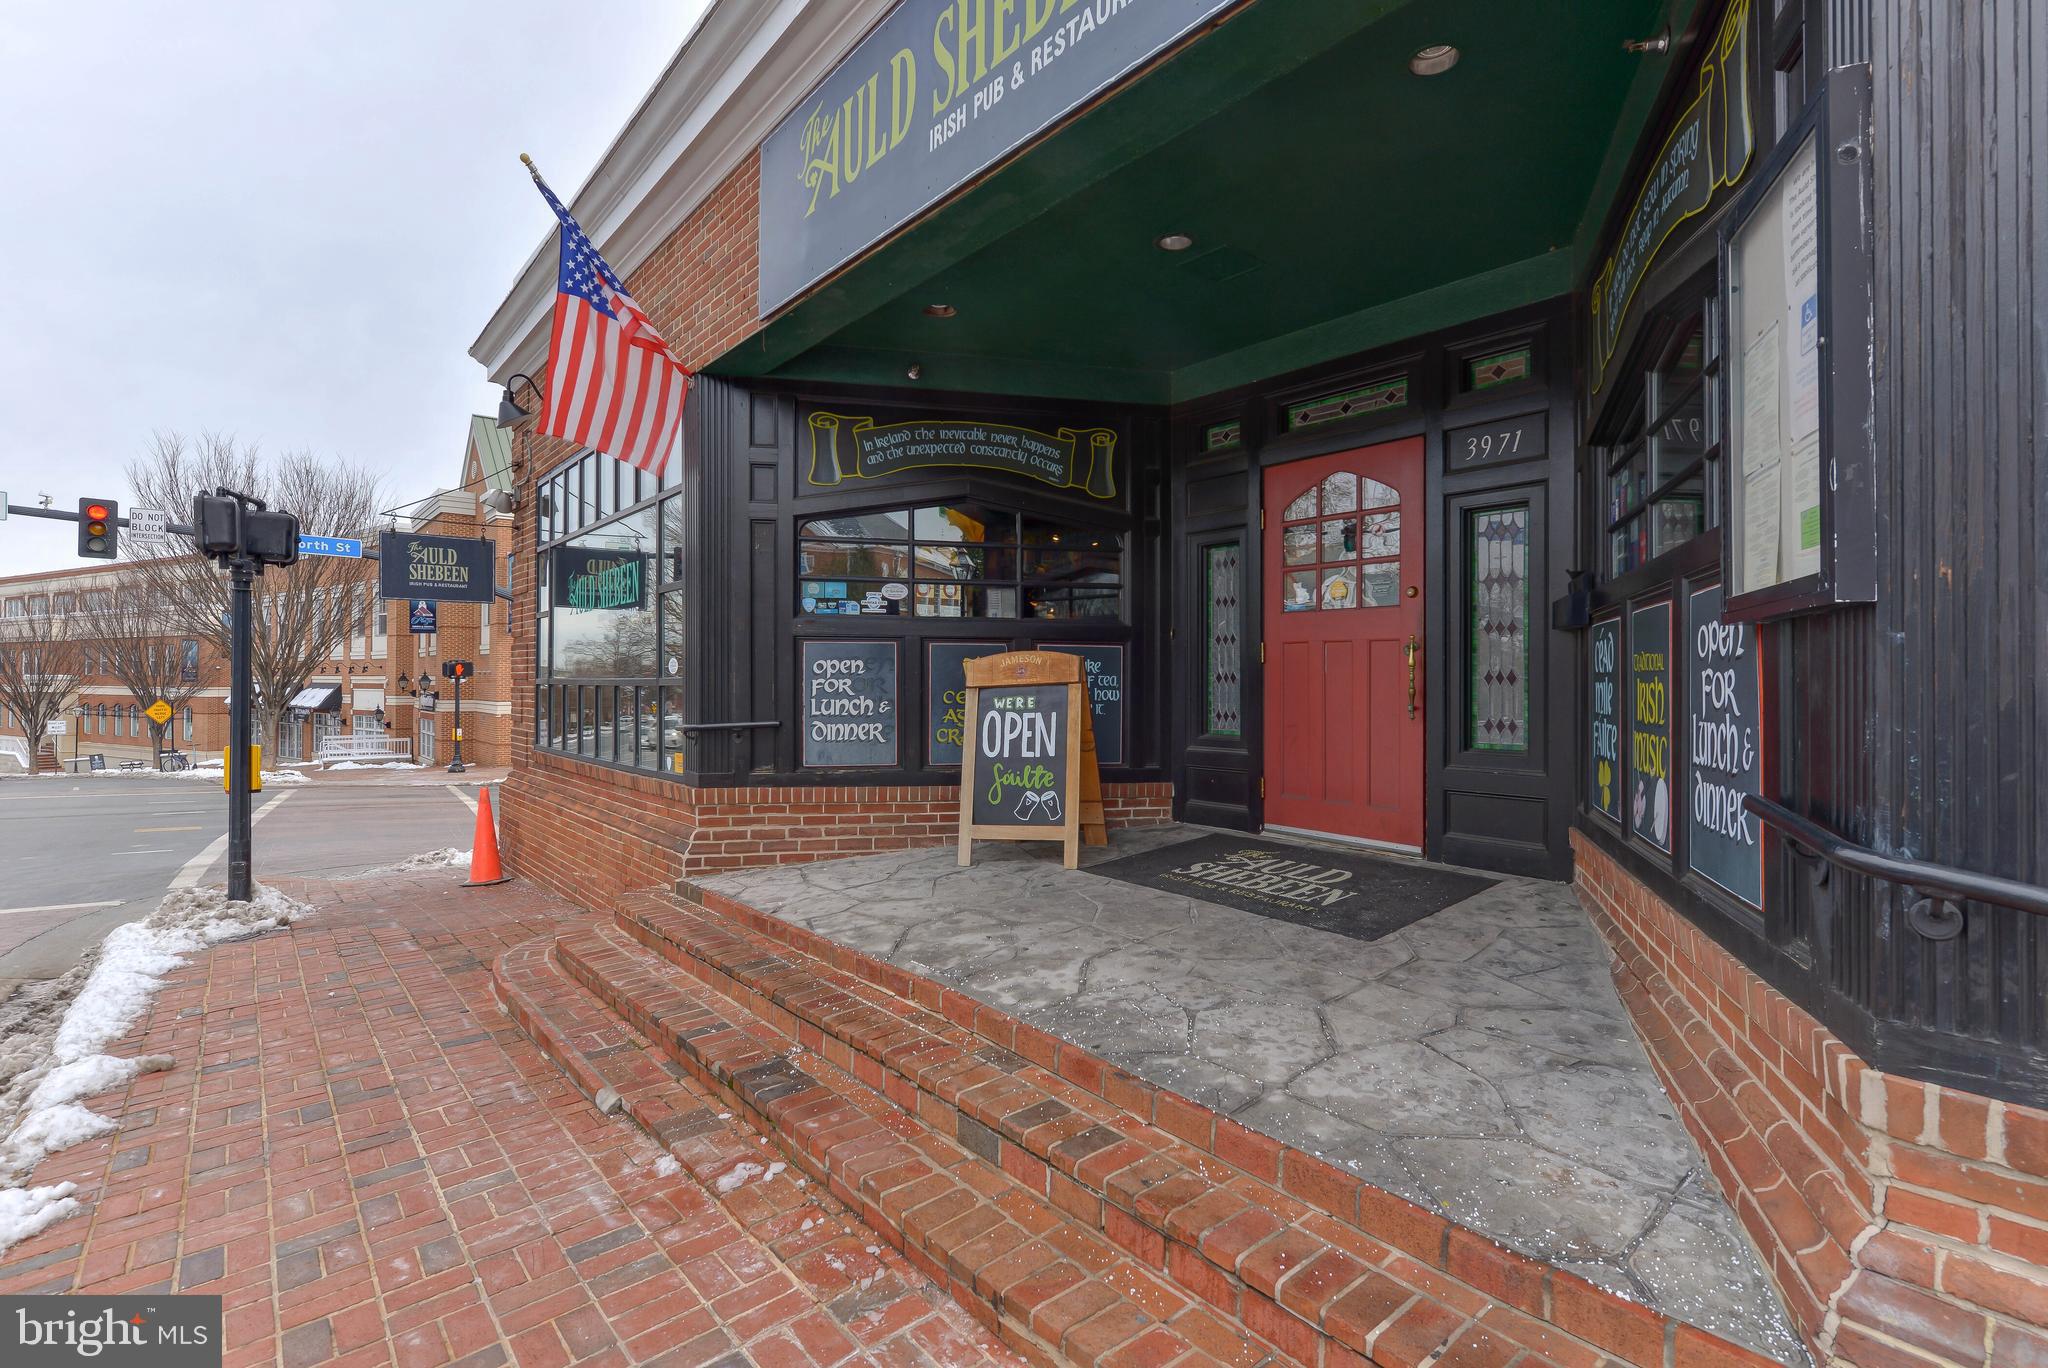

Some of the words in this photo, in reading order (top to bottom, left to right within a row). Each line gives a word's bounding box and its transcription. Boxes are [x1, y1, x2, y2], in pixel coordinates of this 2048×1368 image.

[804, 48, 917, 219] AULD
[932, 0, 1080, 118] SHE
[929, 103, 967, 152] IRISH
[973, 75, 1004, 120] PUB
[1010, 60, 1025, 90] &
[797, 99, 834, 180] The
[1660, 160, 1669, 188] in
[863, 440, 873, 452] In
[874, 430, 912, 448] Ireland
[915, 427, 935, 440] the
[940, 427, 987, 441] inevitable
[991, 432, 1018, 448] never
[1021, 434, 1061, 459] happens
[1465, 429, 1522, 461] 3971
[866, 450, 885, 465] and
[887, 446, 904, 460] the
[906, 442, 966, 457] unexpected
[970, 444, 1028, 465] constantly
[1030, 455, 1064, 477] occurs
[131, 512, 144, 521] DO
[147, 513, 164, 522] NOT
[131, 523, 164, 533] BLOCK
[131, 532, 164, 540] INTERSECTION
[336, 542, 351, 553] St
[411, 547, 458, 566] AULD
[409, 563, 469, 582] SHEBEEN
[598, 560, 640, 609] SHEBEEN
[1000, 655, 1042, 669] JAMESON
[1084, 659, 1101, 674] ke
[1094, 687, 1120, 702] how
[1097, 675, 1119, 689] tea,
[878, 700, 891, 714] &
[982, 710, 1057, 758] OPEN
[1742, 727, 1755, 772] &
[1215, 855, 1353, 884] AULD
[1171, 861, 1361, 907] SHEBEEN
